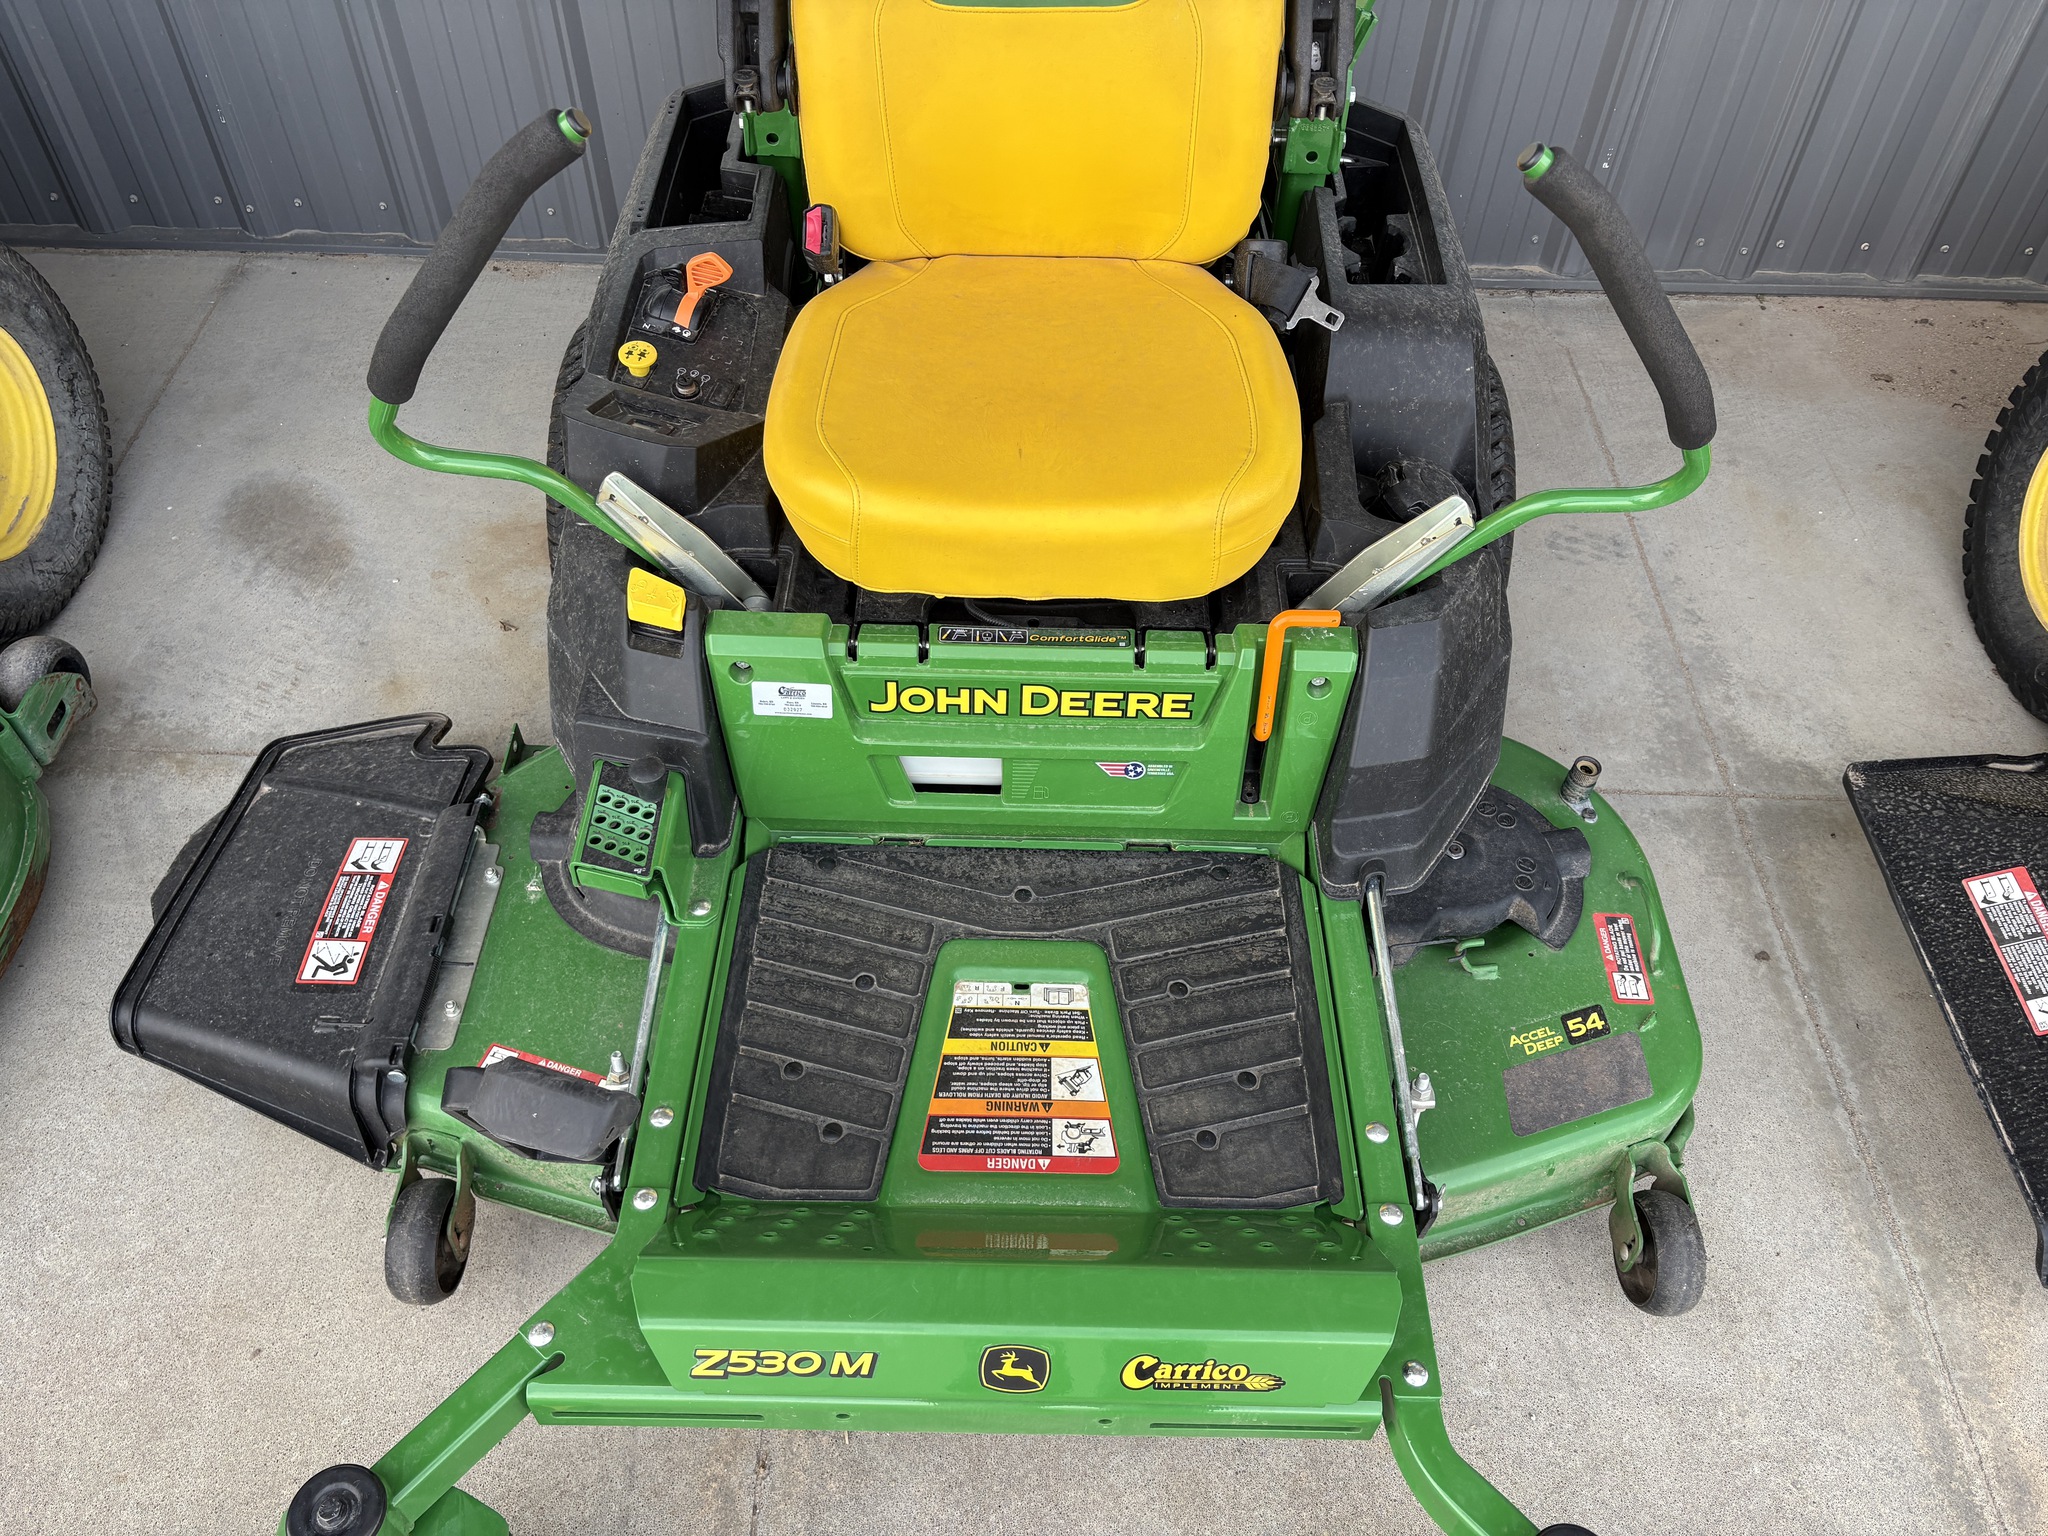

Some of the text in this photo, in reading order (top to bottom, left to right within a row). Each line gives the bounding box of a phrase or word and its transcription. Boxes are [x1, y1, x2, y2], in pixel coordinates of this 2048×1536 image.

[869, 680, 1195, 720] JOHN DEERE
[362, 892, 386, 934] DANGER
[1600, 928, 1611, 953] DANGER
[1566, 1012, 1605, 1038] 54
[990, 1041, 1037, 1052] CAUTION
[1509, 1026, 1556, 1048] ACCEL
[1524, 1036, 1563, 1056] DEEP
[548, 1060, 582, 1077] DANGER
[986, 1101, 1039, 1112] WARNING
[987, 1158, 1036, 1169] DANGER
[690, 1349, 878, 1379] Z530 M
[1121, 1354, 1248, 1389] Carrico
